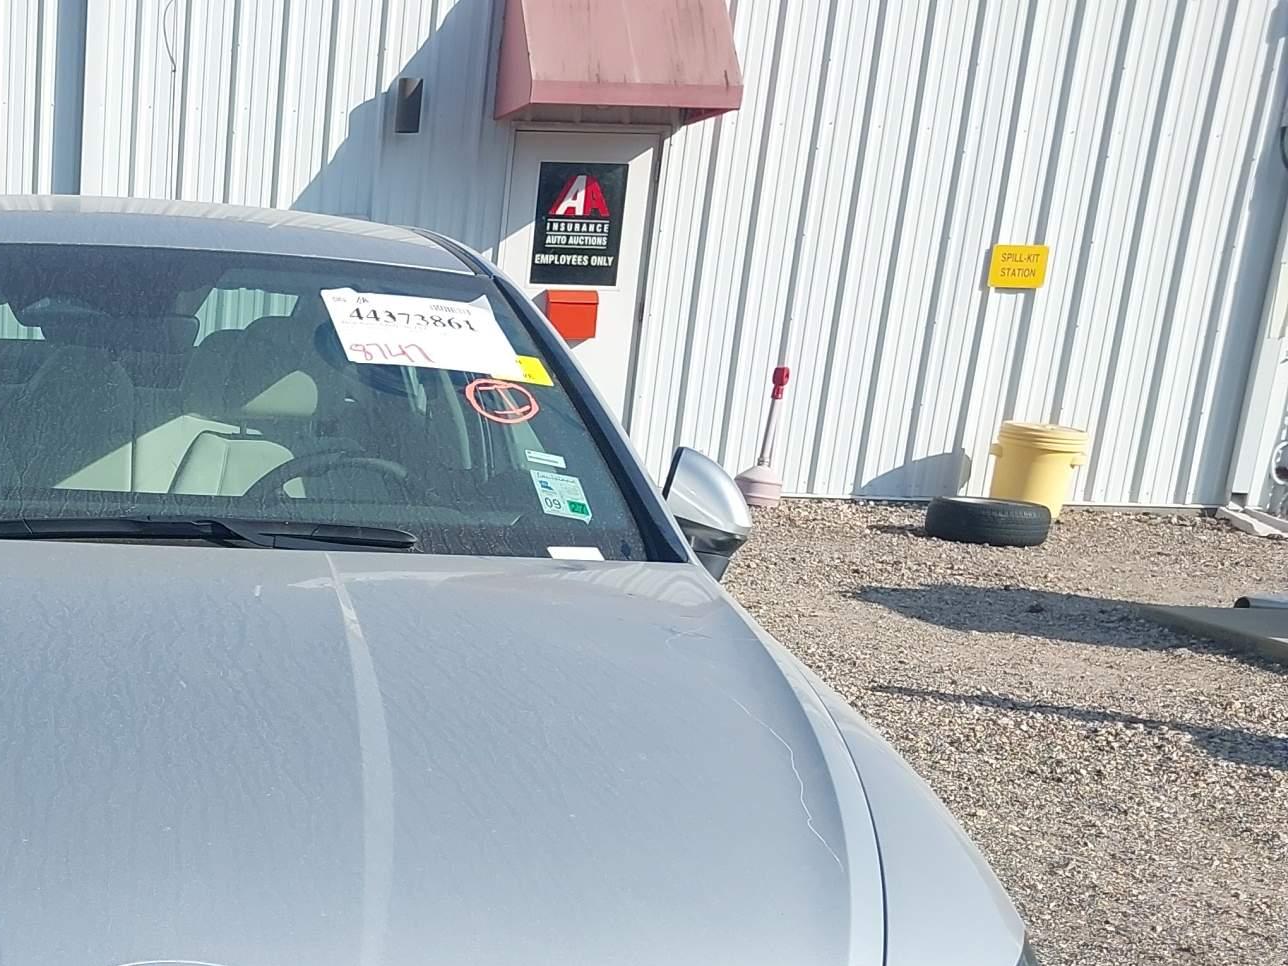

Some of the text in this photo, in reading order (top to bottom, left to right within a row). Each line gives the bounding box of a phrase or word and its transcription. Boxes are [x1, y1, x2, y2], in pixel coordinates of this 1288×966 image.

[546, 222, 610, 233] INSURANCE
[545, 235, 608, 246] AUTO AUCTIONS
[534, 253, 614, 266] EMPLOYEES ONLY
[1000, 252, 1040, 264] SPILL-KIT
[999, 267, 1037, 279] STATION
[349, 306, 478, 333] 44373861
[349, 343, 436, 363] 8747
[544, 497, 562, 510] 09
